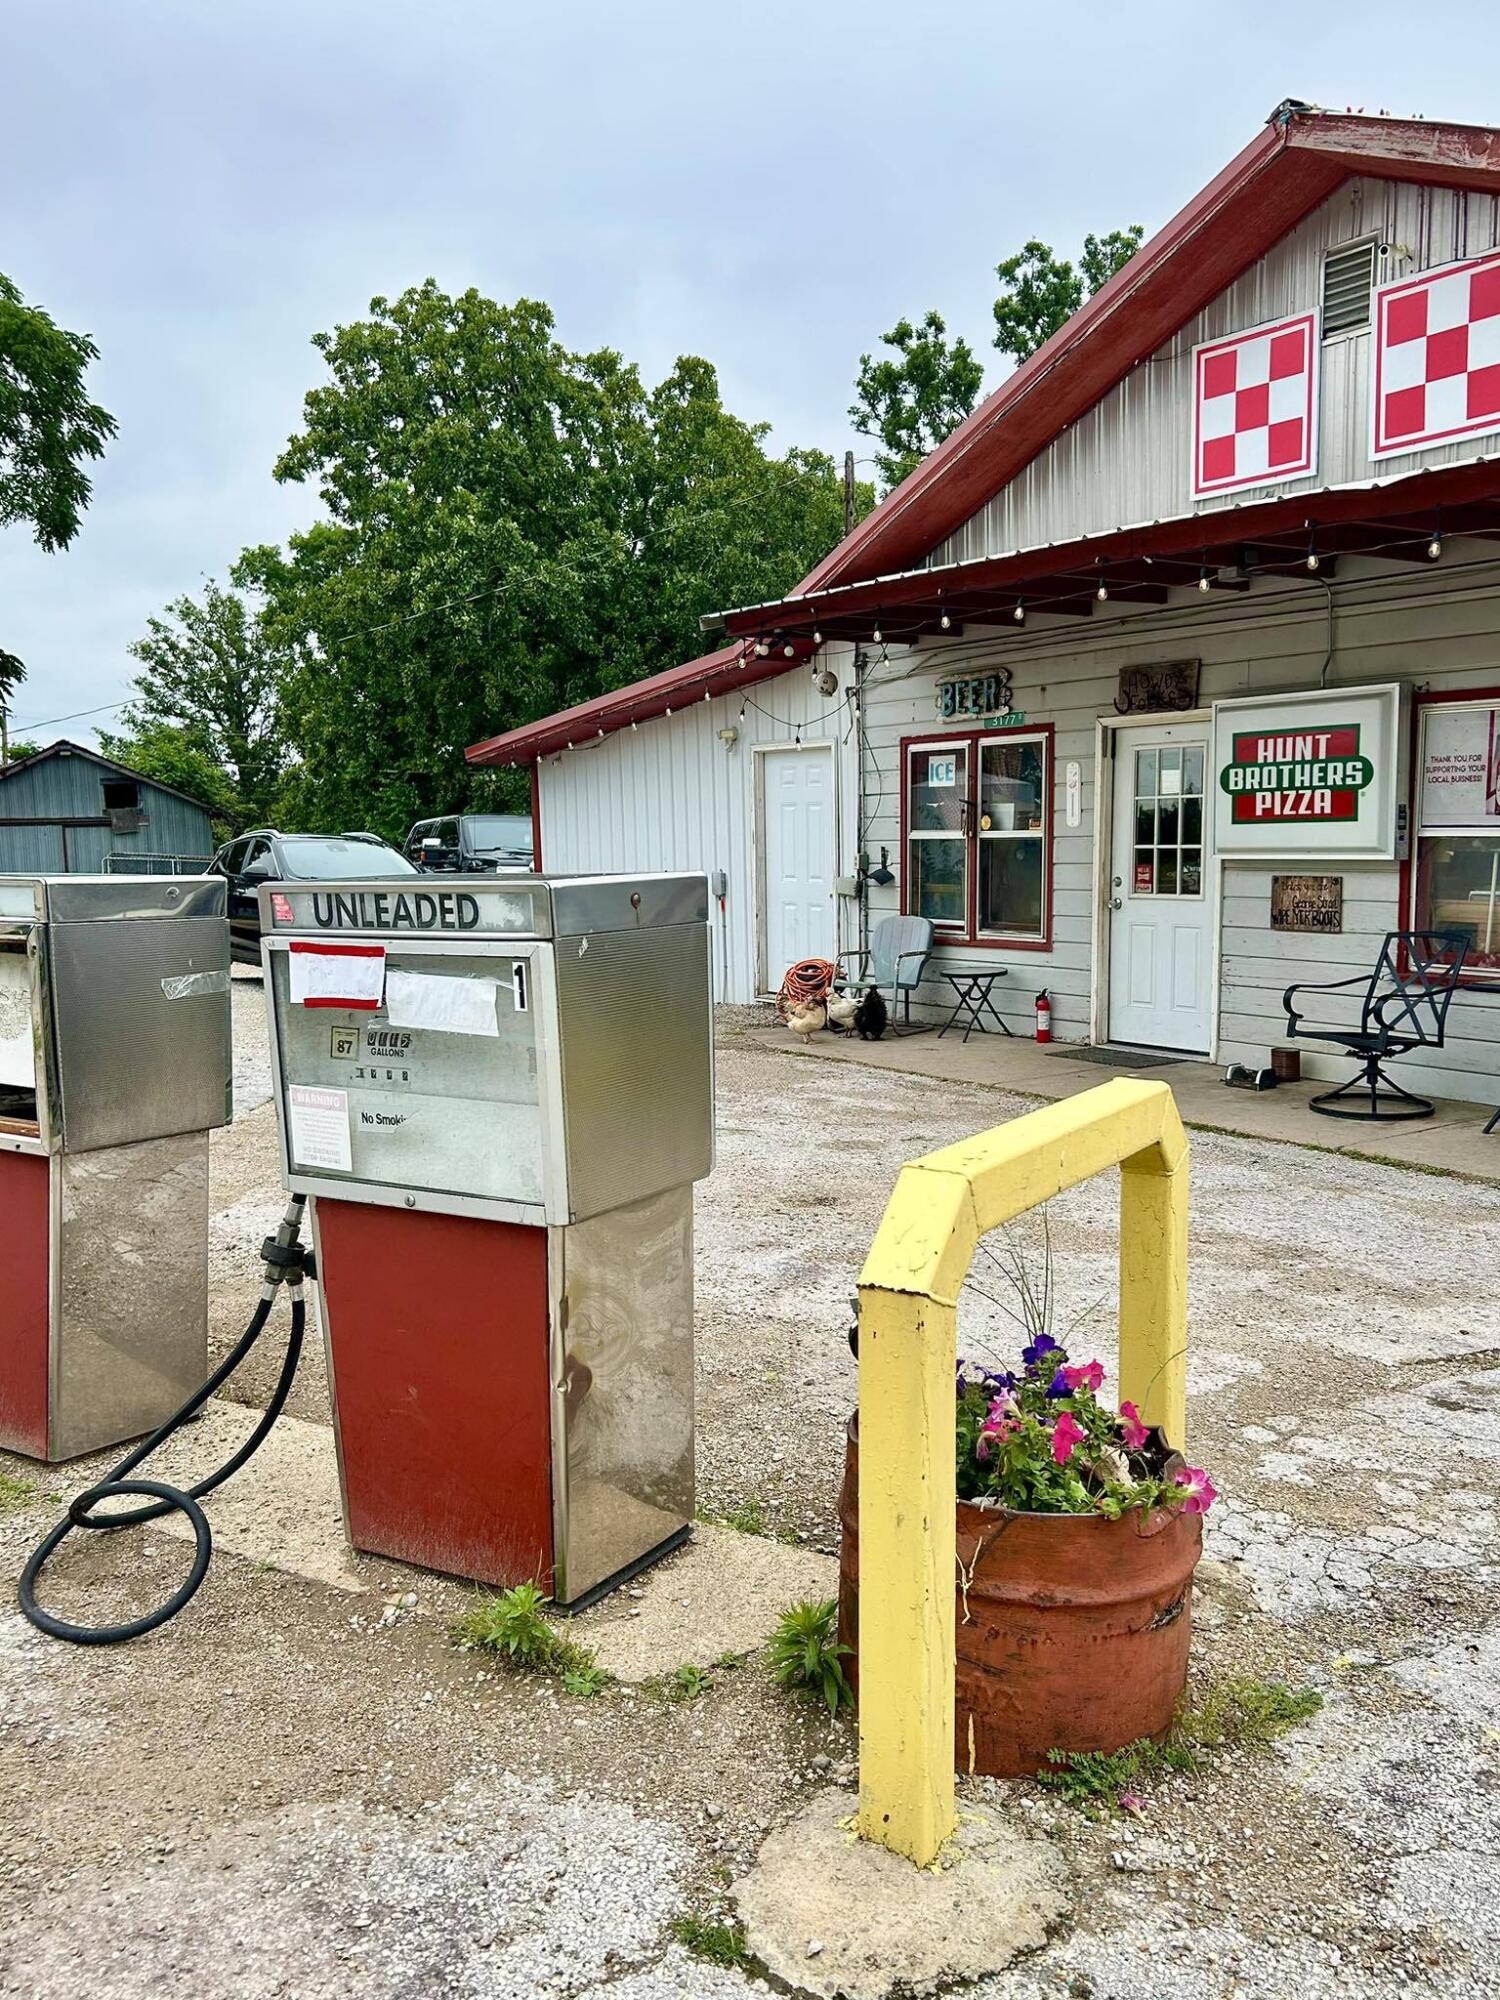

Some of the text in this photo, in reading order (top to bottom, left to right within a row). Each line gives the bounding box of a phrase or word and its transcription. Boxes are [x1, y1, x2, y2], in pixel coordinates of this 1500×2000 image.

[941, 679, 996, 716] BEER
[992, 714, 1016, 726] 3177
[1257, 734, 1331, 763] HUNT
[1431, 754, 1482, 764] THANK YOU FOR
[929, 762, 954, 782] ICE
[1229, 761, 1363, 791] BROTHERS
[1426, 764, 1486, 774] SUPPORTING YOUR
[1428, 776, 1449, 784] LOCAL
[1255, 789, 1332, 816] PIZZA
[312, 893, 479, 929] UNLEADED
[1311, 910, 1340, 927] BOOTS
[514, 965, 525, 1009] 1
[337, 1040, 353, 1054] 87
[371, 1047, 404, 1058] GALLONS
[295, 1090, 340, 1107] WARNING
[361, 1112, 374, 1124] No
